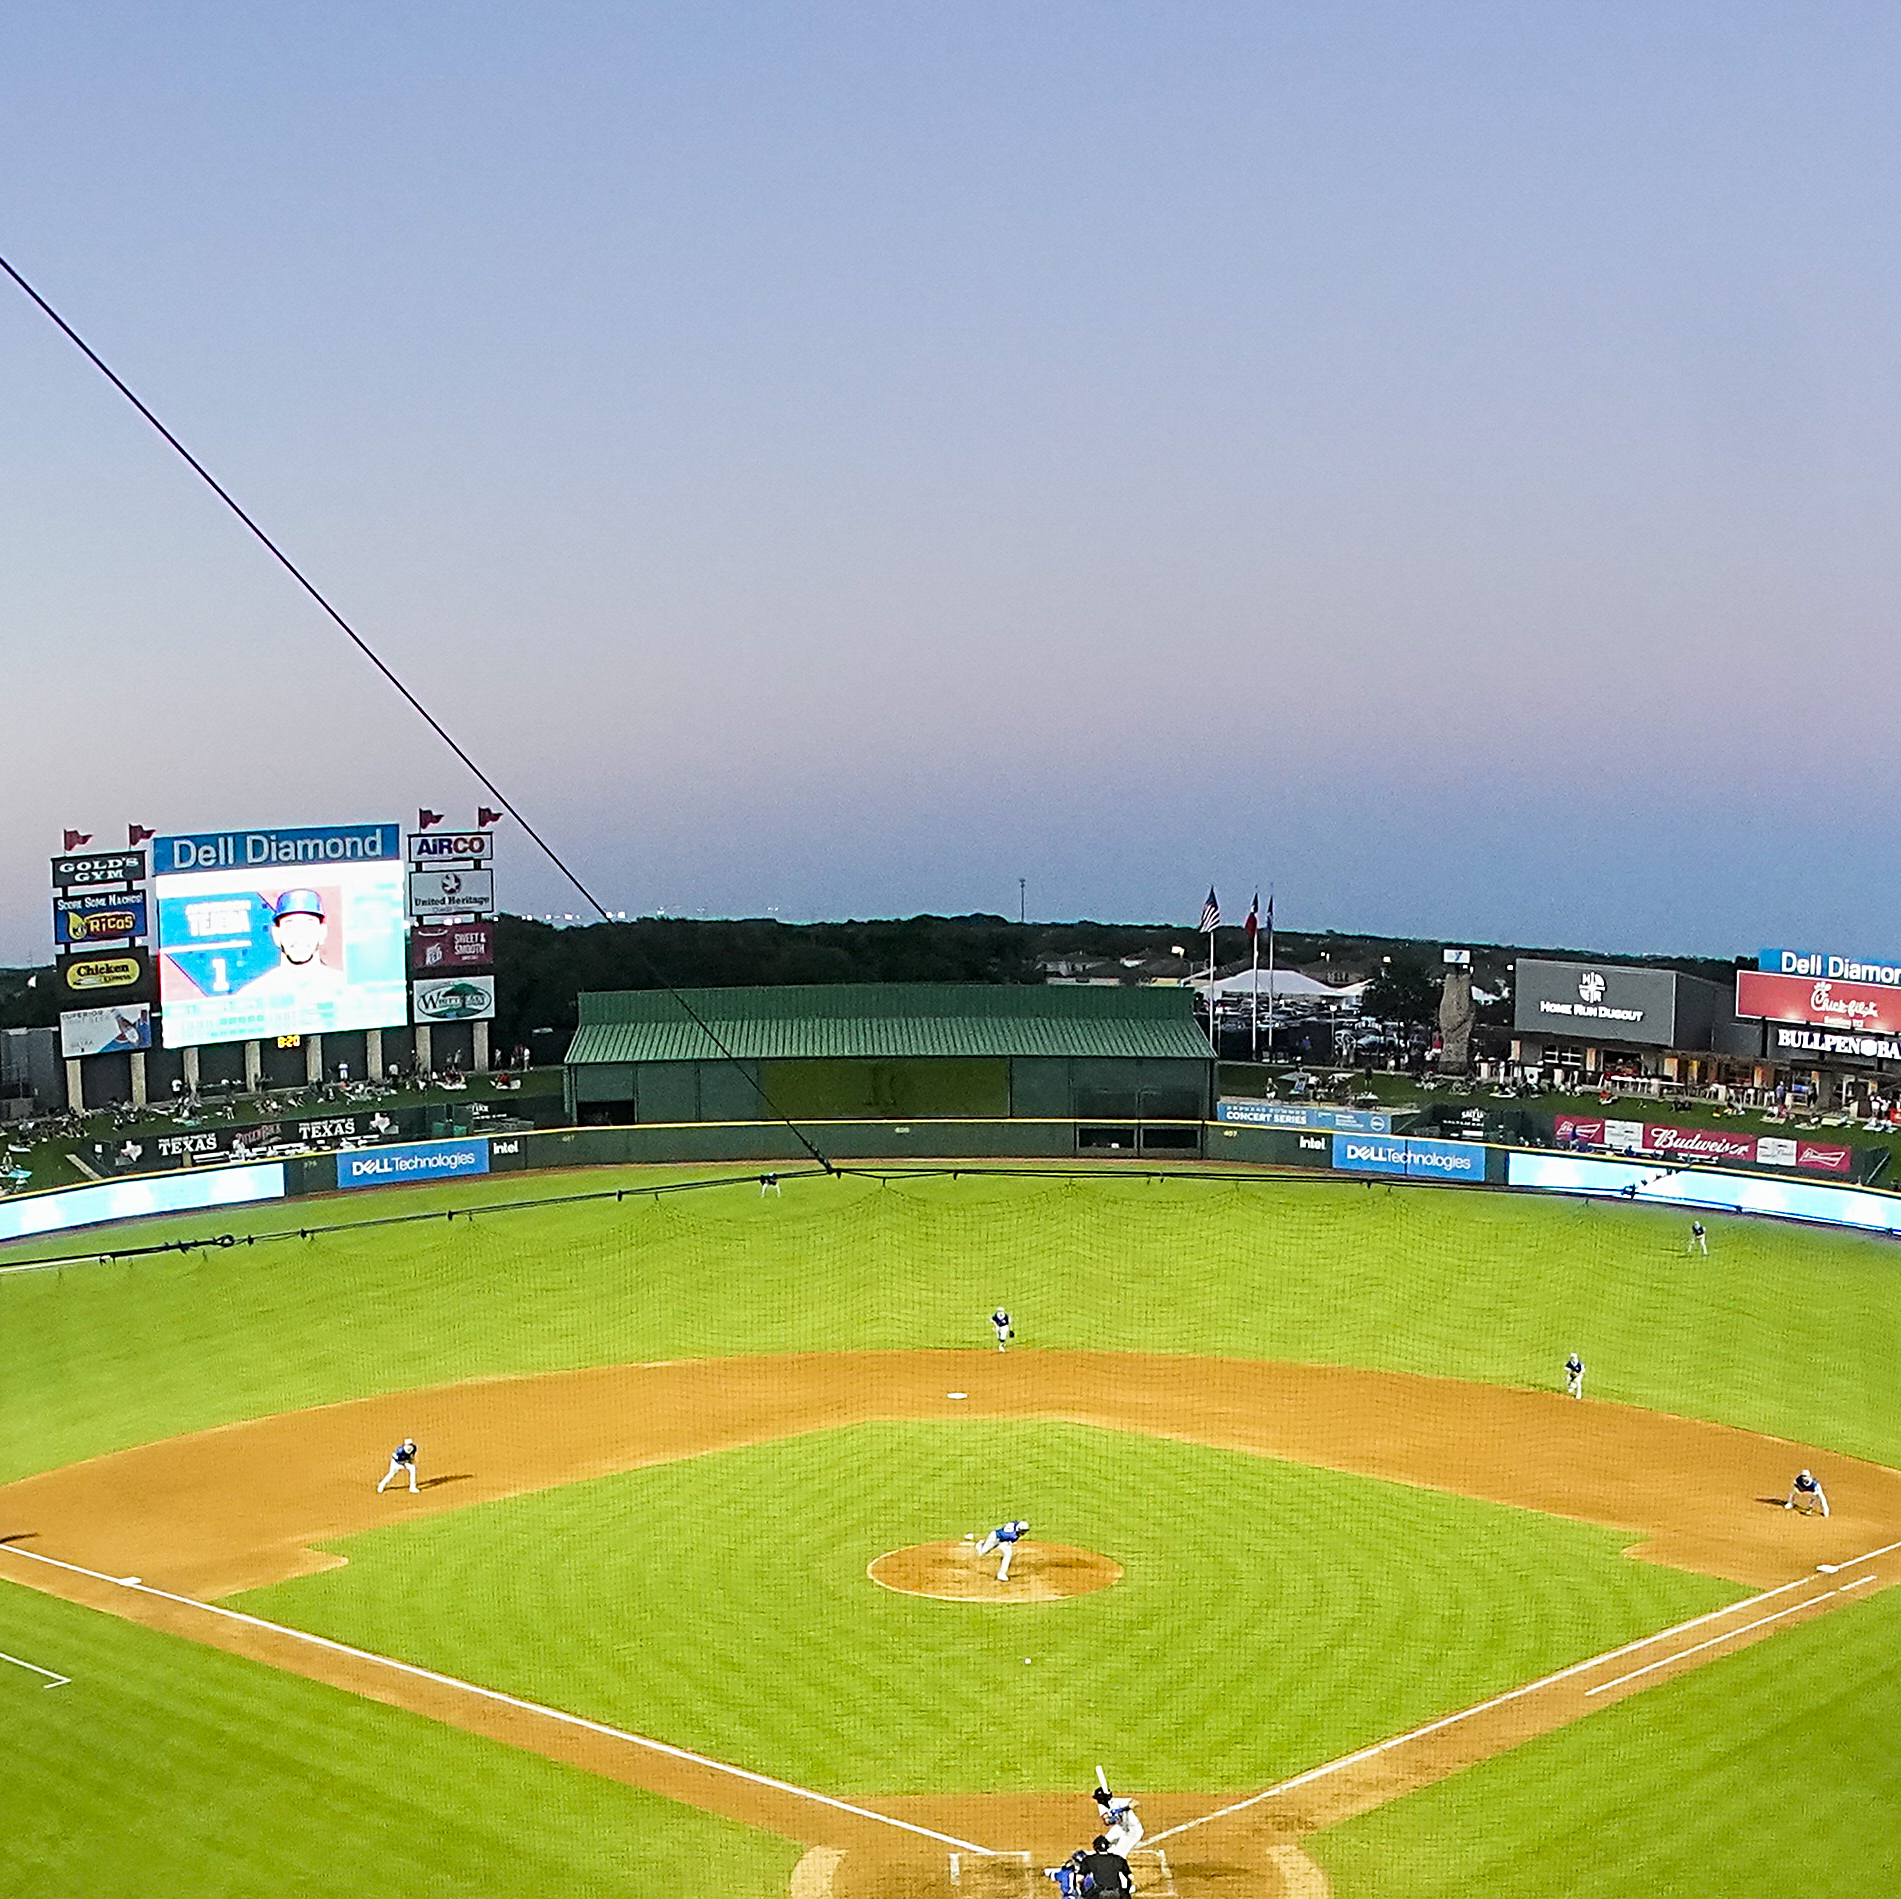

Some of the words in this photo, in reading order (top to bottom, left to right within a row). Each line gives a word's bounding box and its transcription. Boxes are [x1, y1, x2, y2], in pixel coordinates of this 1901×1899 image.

[173, 837, 234, 869] Dell
[246, 828, 383, 863] Diamond
[59, 858, 139, 872] GOLD'S
[74, 870, 124, 881] GYM
[415, 896, 446, 907] United
[448, 895, 490, 906] Heritage
[76, 963, 130, 977] Chicken
[1781, 951, 1822, 976] Dell
[1540, 1001, 1573, 1016] HOME
[1574, 1003, 1598, 1018] RUN
[1600, 1005, 1644, 1022] DUGOUT
[1778, 1028, 1862, 1054] BULLPEN
[1226, 1111, 1272, 1122] CONCERT
[1274, 1115, 1307, 1125] SERIES
[299, 1120, 356, 1139] TEXAS
[159, 1136, 217, 1156] TEXAS
[493, 1140, 519, 1155] intel
[1299, 1135, 1326, 1151] intel
[1650, 1127, 1750, 1157] Budweiser
[352, 1157, 392, 1176] DELL
[392, 1151, 476, 1172] Technologies
[1347, 1144, 1387, 1162] DELL
[1387, 1147, 1472, 1172] Technologies
